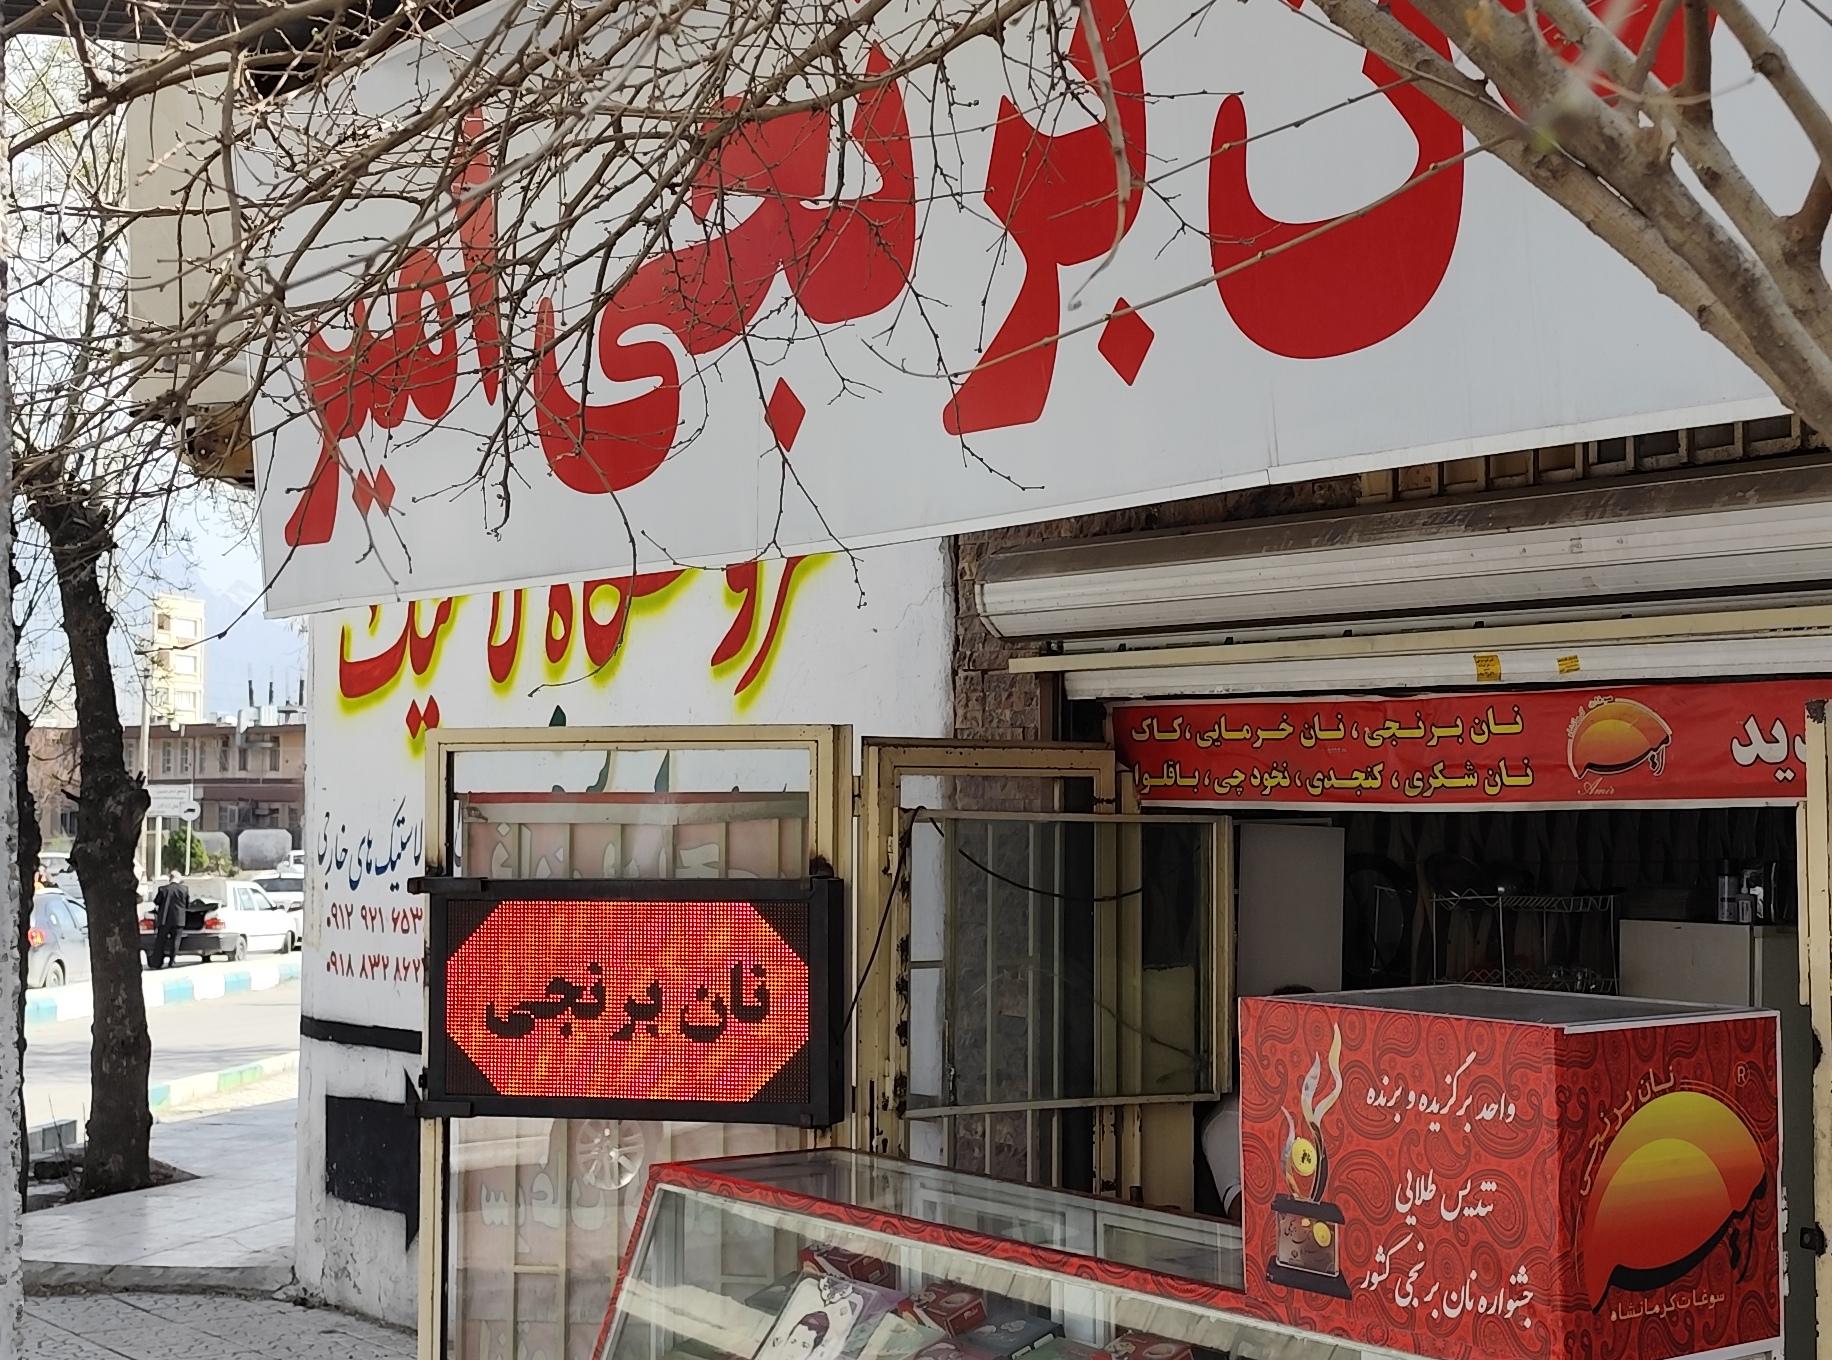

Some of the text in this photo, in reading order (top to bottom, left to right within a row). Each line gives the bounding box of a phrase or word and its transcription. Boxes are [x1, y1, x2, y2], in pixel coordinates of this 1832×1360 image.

[284, 106, 502, 548] امیر
[1131, 715, 1184, 742] کاک
[1299, 711, 1346, 749] نان
[1470, 703, 1524, 747] نان
[1484, 757, 1535, 797] نان
[486, 960, 770, 1043] نان برنجی
[1366, 1075, 1403, 1124] برنده
[1418, 1050, 1477, 1133] برگزیده
[1476, 1092, 1517, 1123] واحد
[1637, 1065, 1675, 1103] نان
[1395, 1168, 1498, 1226] تندیس طلایی
[1360, 1232, 1414, 1291] کشور
[1442, 1269, 1478, 1318] نان
[1478, 1265, 1534, 1328] جشنواره
